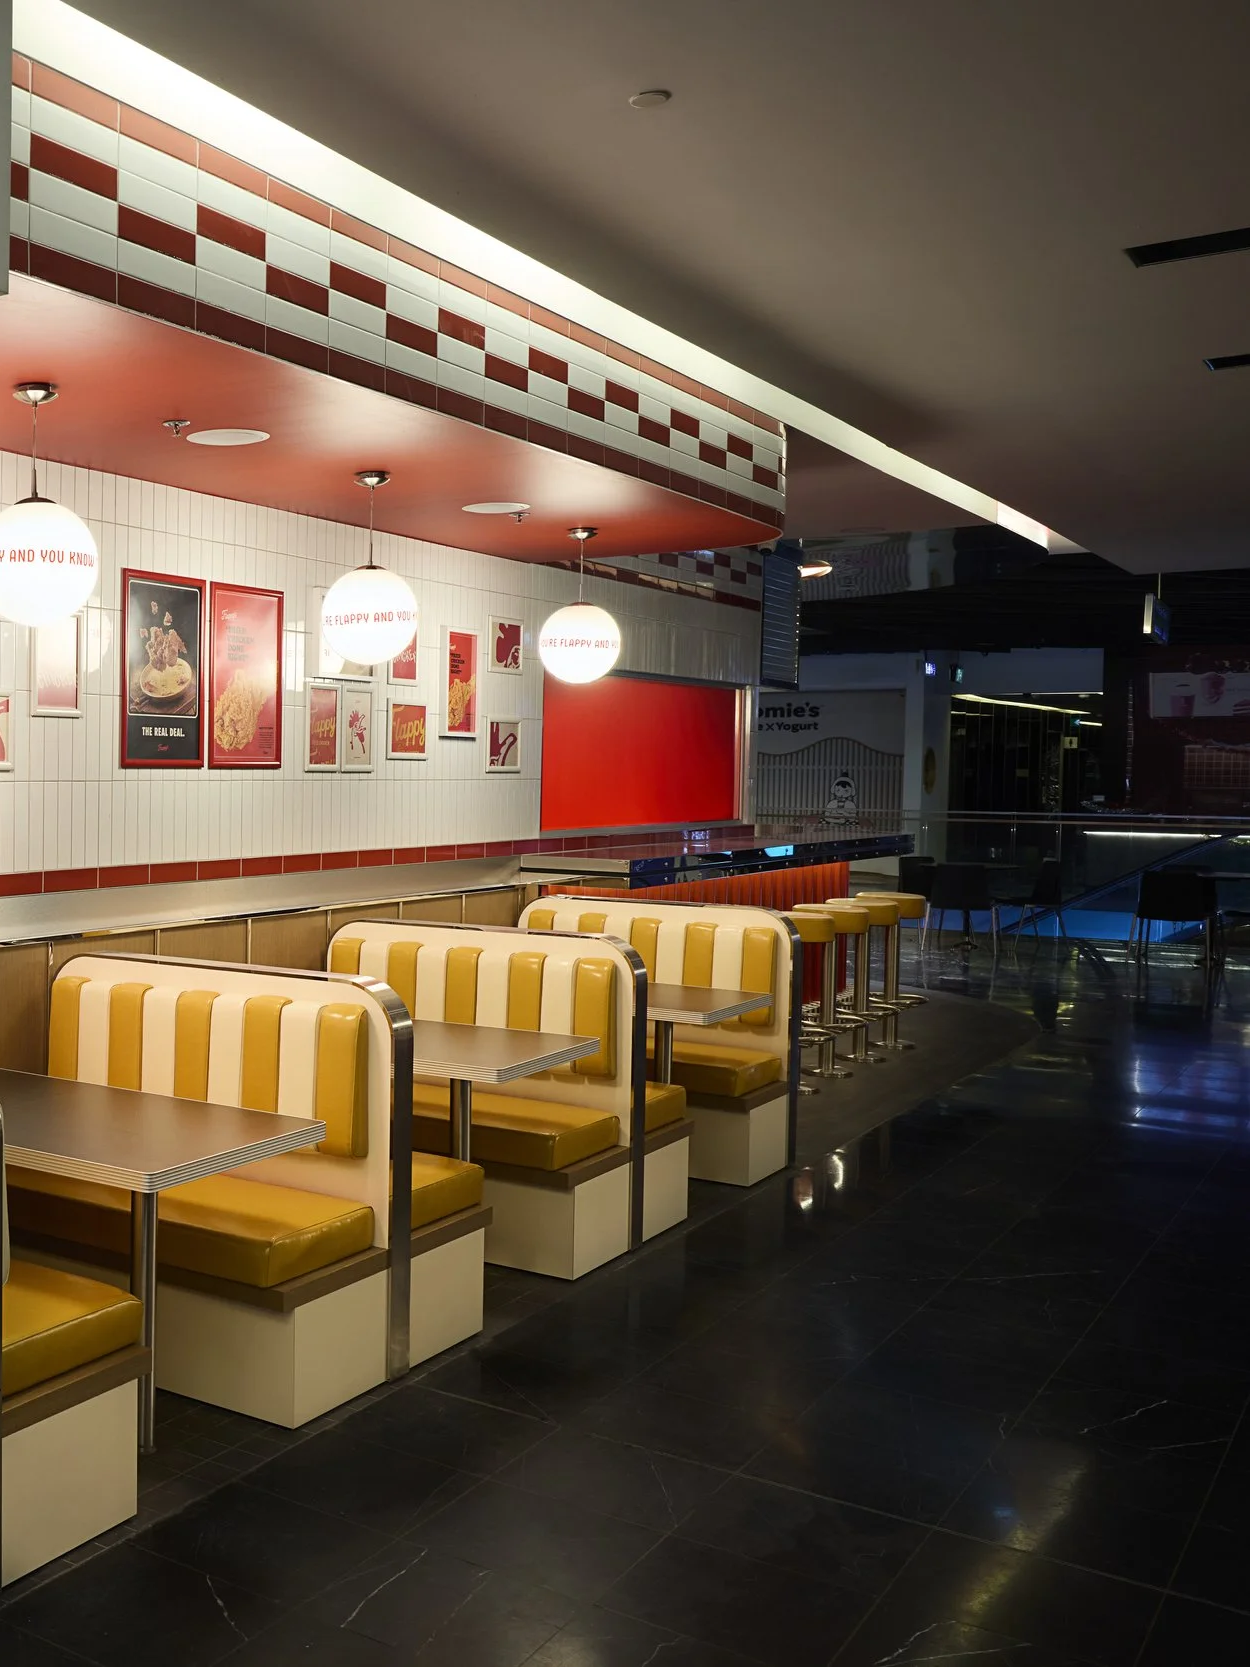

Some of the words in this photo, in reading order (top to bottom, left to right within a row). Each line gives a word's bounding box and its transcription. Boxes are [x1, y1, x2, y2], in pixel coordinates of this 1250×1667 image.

[9, 548, 35, 563] AND
[40, 549, 65, 564] YOU
[69, 550, 95, 568] KNOW
[335, 612, 370, 626] FLAPPY
[373, 611, 394, 623] AND
[397, 610, 411, 622] YOU
[559, 638, 592, 648] FLAPPY
[594, 639, 610, 649] AND
[141, 726, 153, 736] THE
[153, 726, 169, 737] REAL
[169, 727, 186, 738] DEAL.
[310, 716, 336, 738] lappy
[393, 716, 426, 746] lappy
[775, 721, 819, 733] Yogurt
